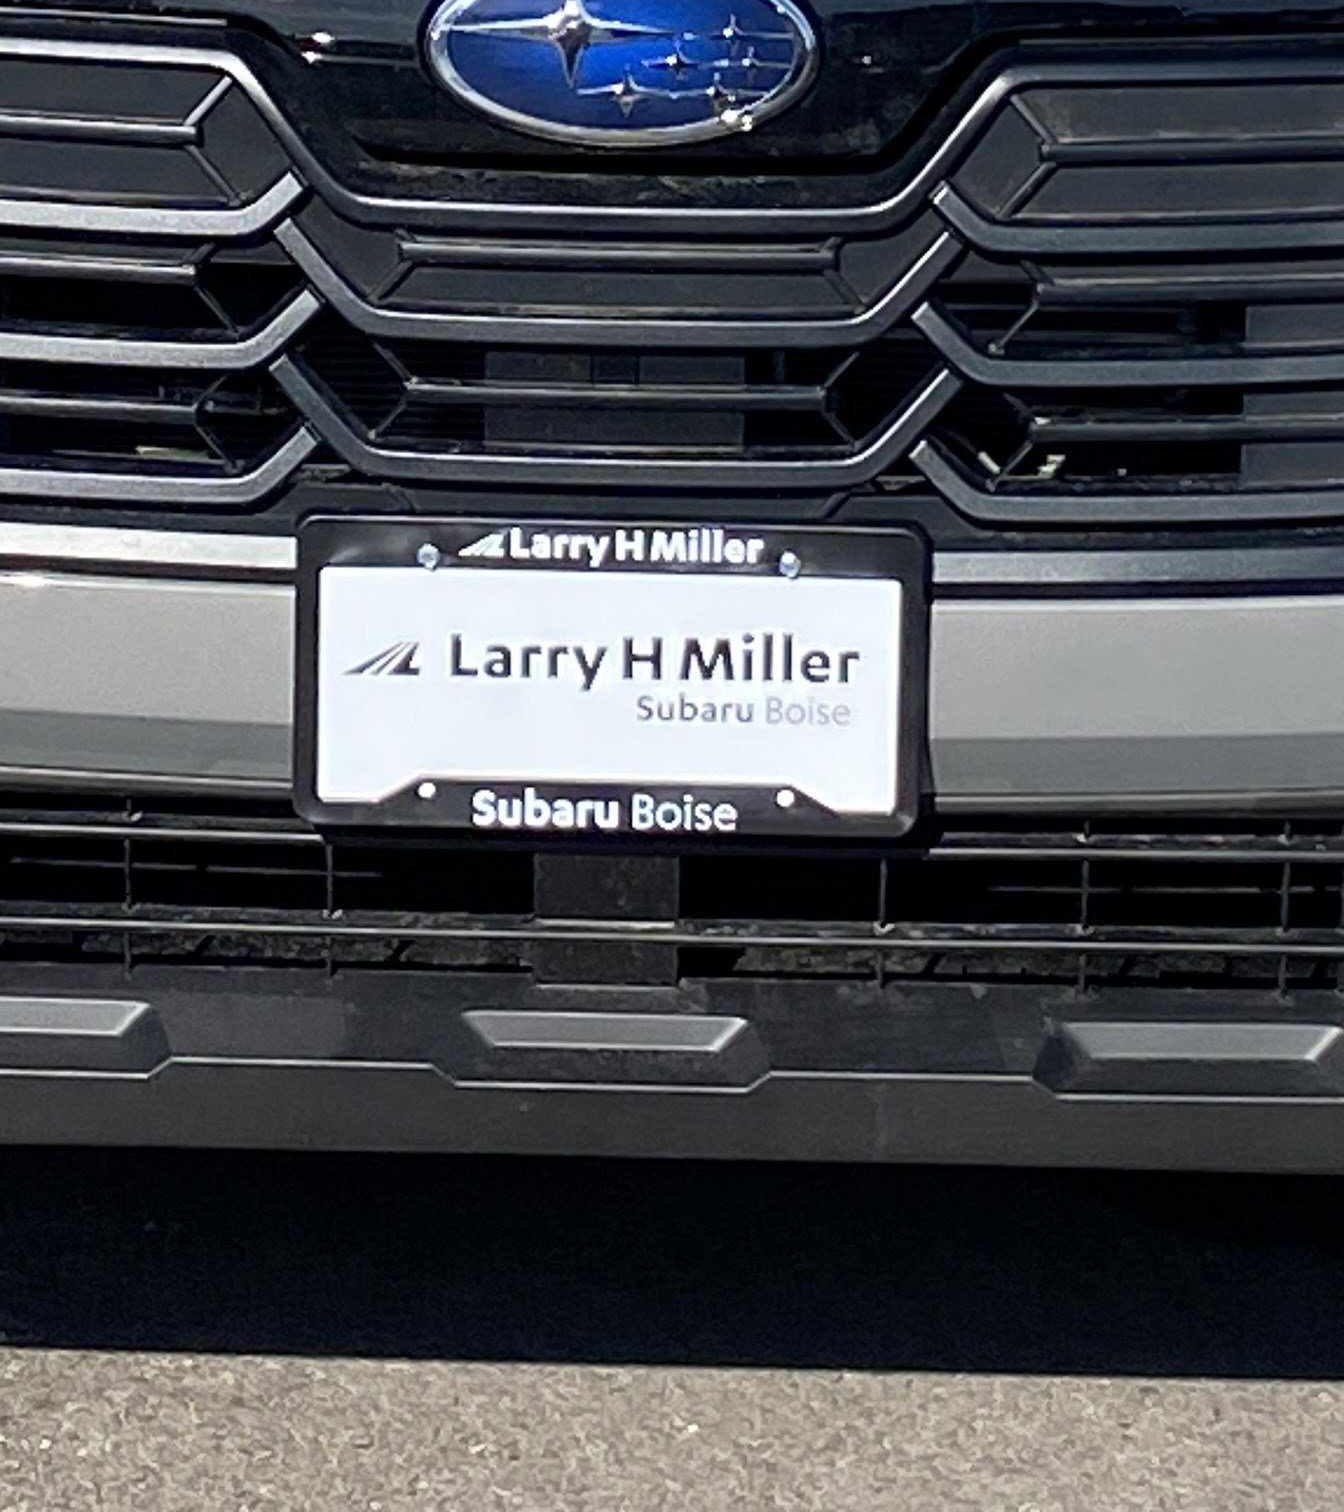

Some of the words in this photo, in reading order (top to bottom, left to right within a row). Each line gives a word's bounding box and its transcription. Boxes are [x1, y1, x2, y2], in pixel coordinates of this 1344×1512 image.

[509, 526, 610, 568] Larry
[615, 528, 645, 561] H
[650, 528, 765, 564] Miller
[450, 633, 608, 691] Larry
[623, 637, 663, 681] H
[678, 633, 861, 684] Miller
[636, 693, 754, 724] Subaru
[765, 696, 852, 726] Boise
[472, 787, 619, 829] Subaru
[631, 793, 738, 831] Boise
